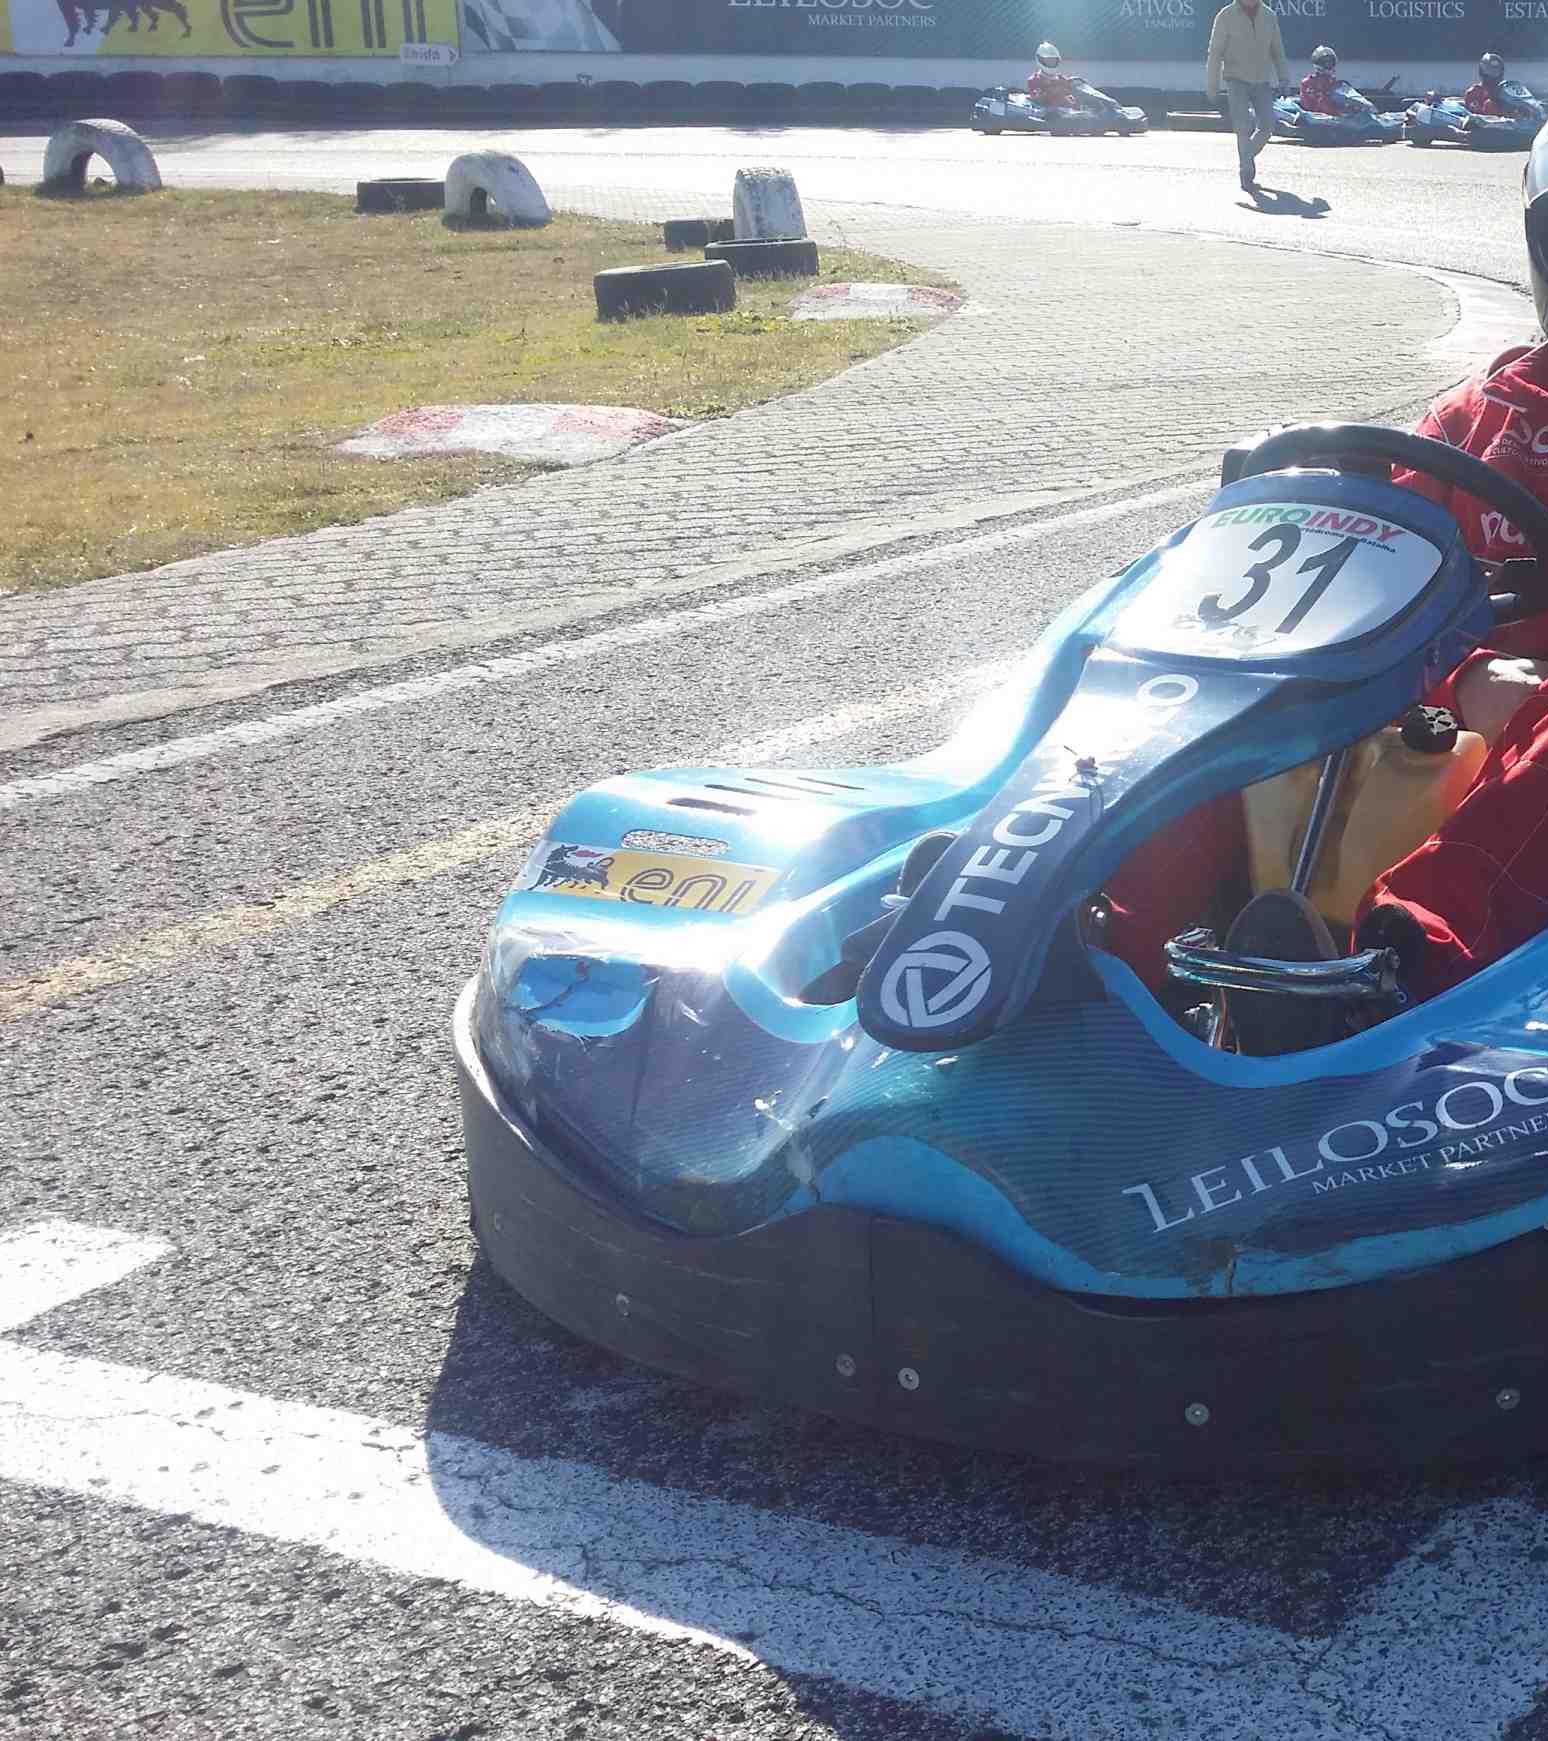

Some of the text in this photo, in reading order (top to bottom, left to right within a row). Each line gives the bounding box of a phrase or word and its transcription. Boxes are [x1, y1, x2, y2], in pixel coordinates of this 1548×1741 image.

[808, 14, 937, 27] MARKET PARTNERS
[1273, 0, 1328, 17] ANCE
[1369, 1, 1465, 18] LOGISTICS
[1211, 505, 1407, 542] EUROINDY
[1197, 522, 1361, 635] 31
[619, 867, 755, 913] eni
[1311, 1152, 1432, 1195] MARKET
